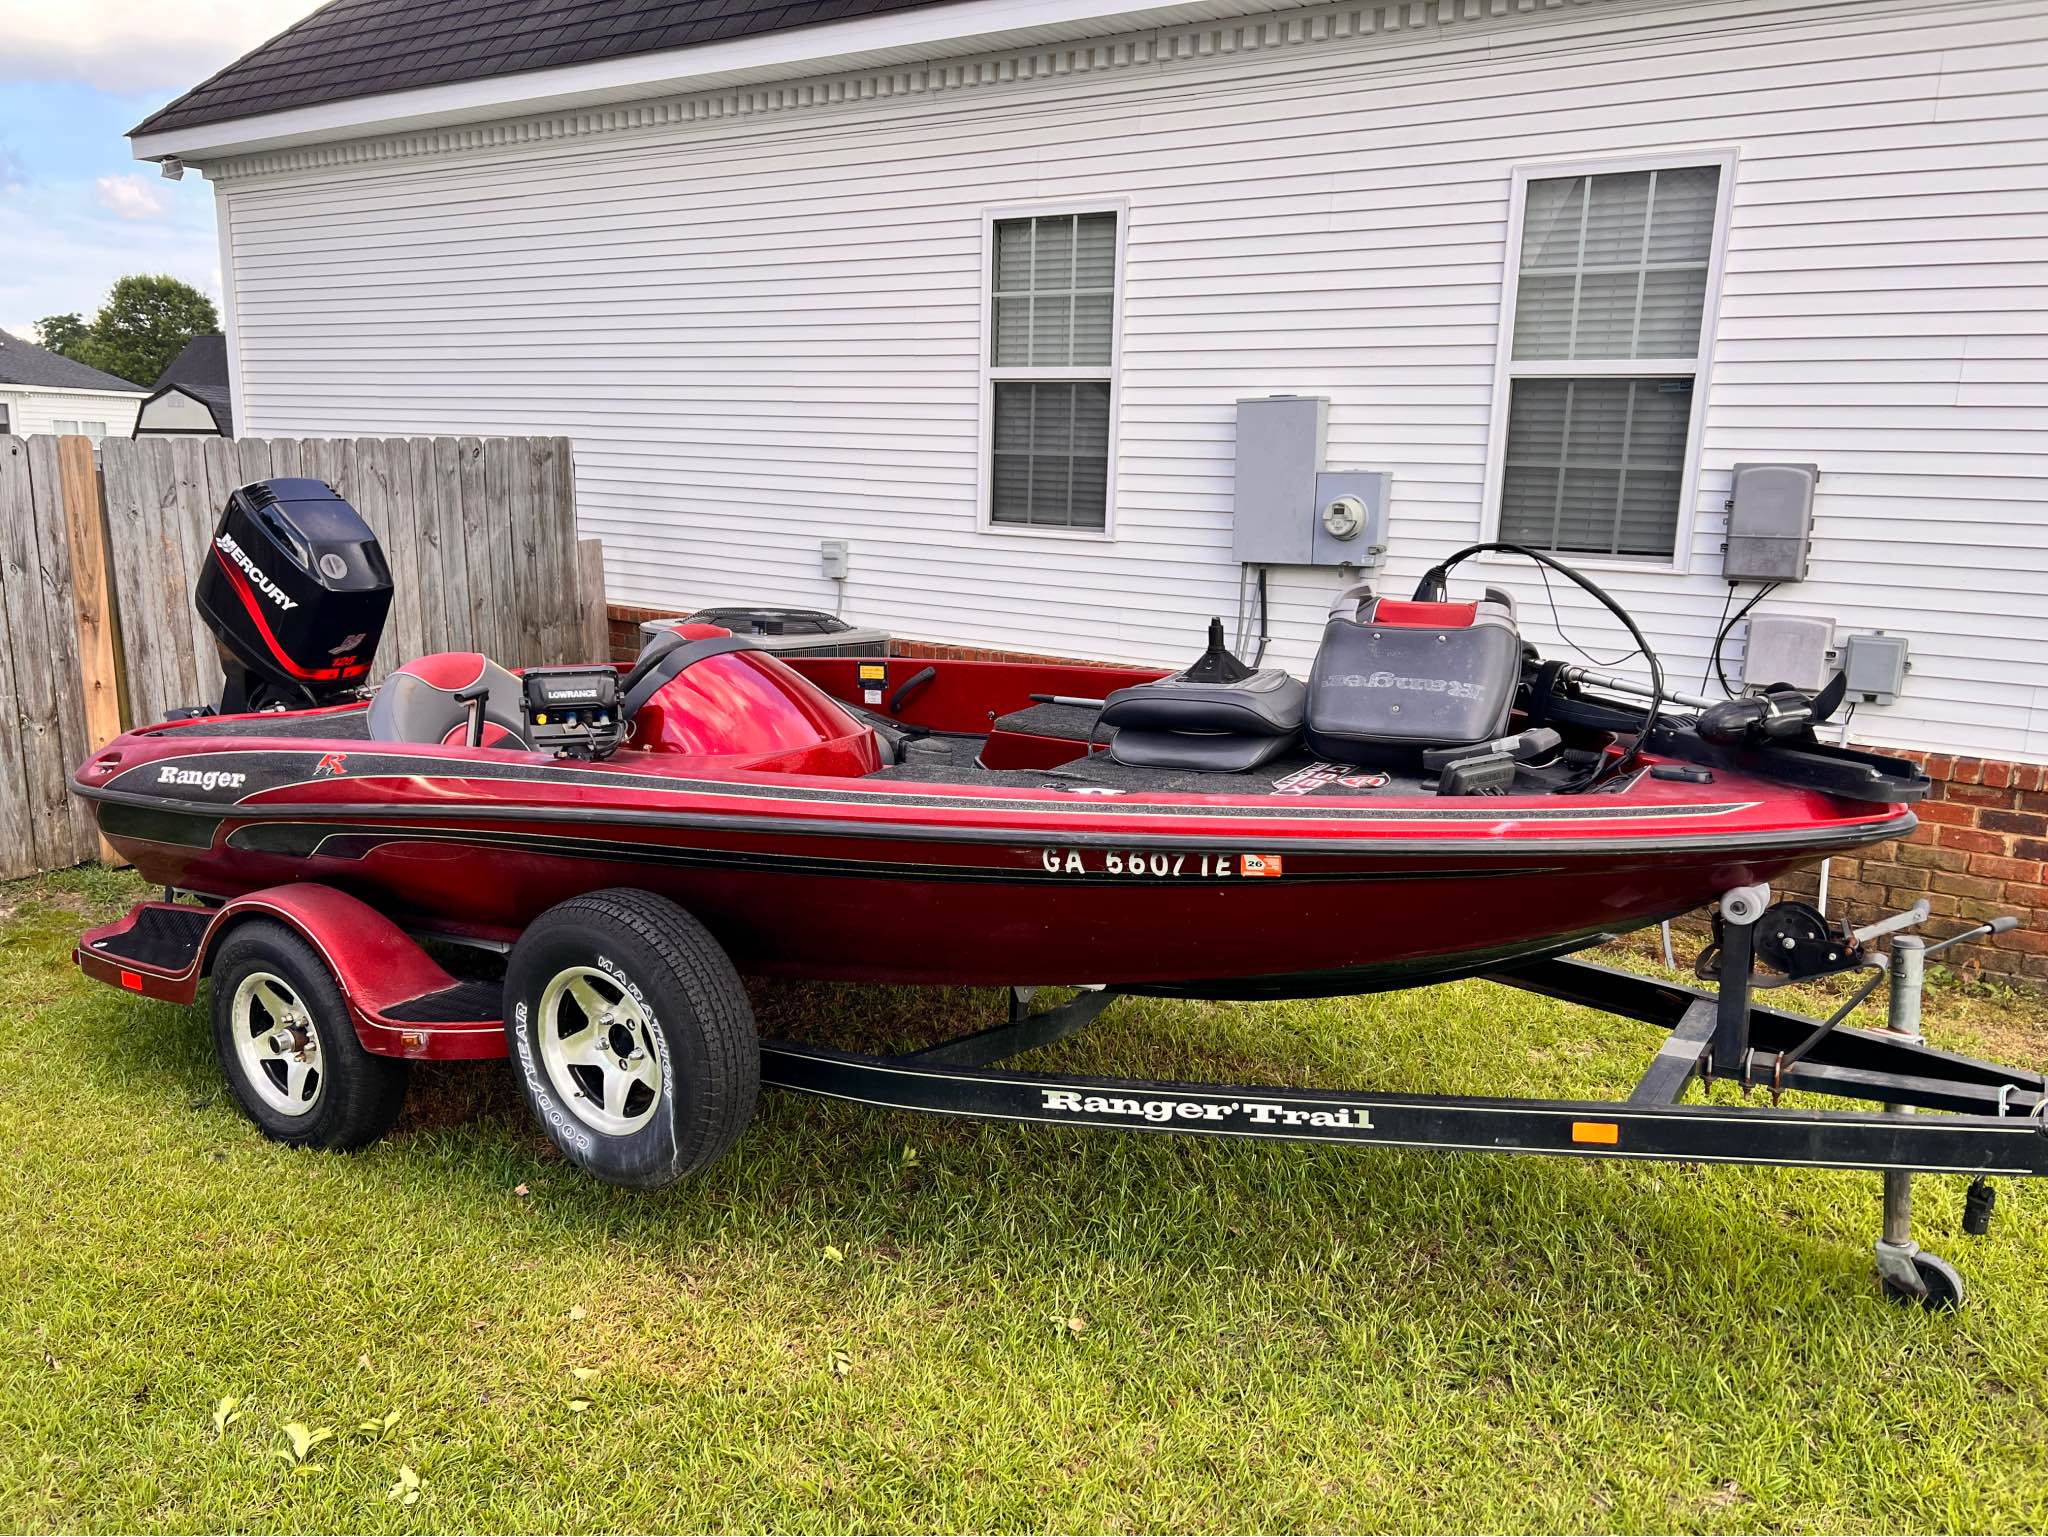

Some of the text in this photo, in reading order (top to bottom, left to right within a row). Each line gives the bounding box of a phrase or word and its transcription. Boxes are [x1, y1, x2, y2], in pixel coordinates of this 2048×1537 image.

[215, 532, 299, 611] MERCURY
[548, 689, 597, 699] LOWRANCE
[157, 766, 246, 791] Ranger
[1042, 847, 1085, 874] GA
[1247, 860, 1263, 868] 26
[598, 955, 674, 1097] MARATHON
[515, 1001, 590, 1150] GOODYEAR
[1041, 1089, 1375, 1129] Ranger Trail
